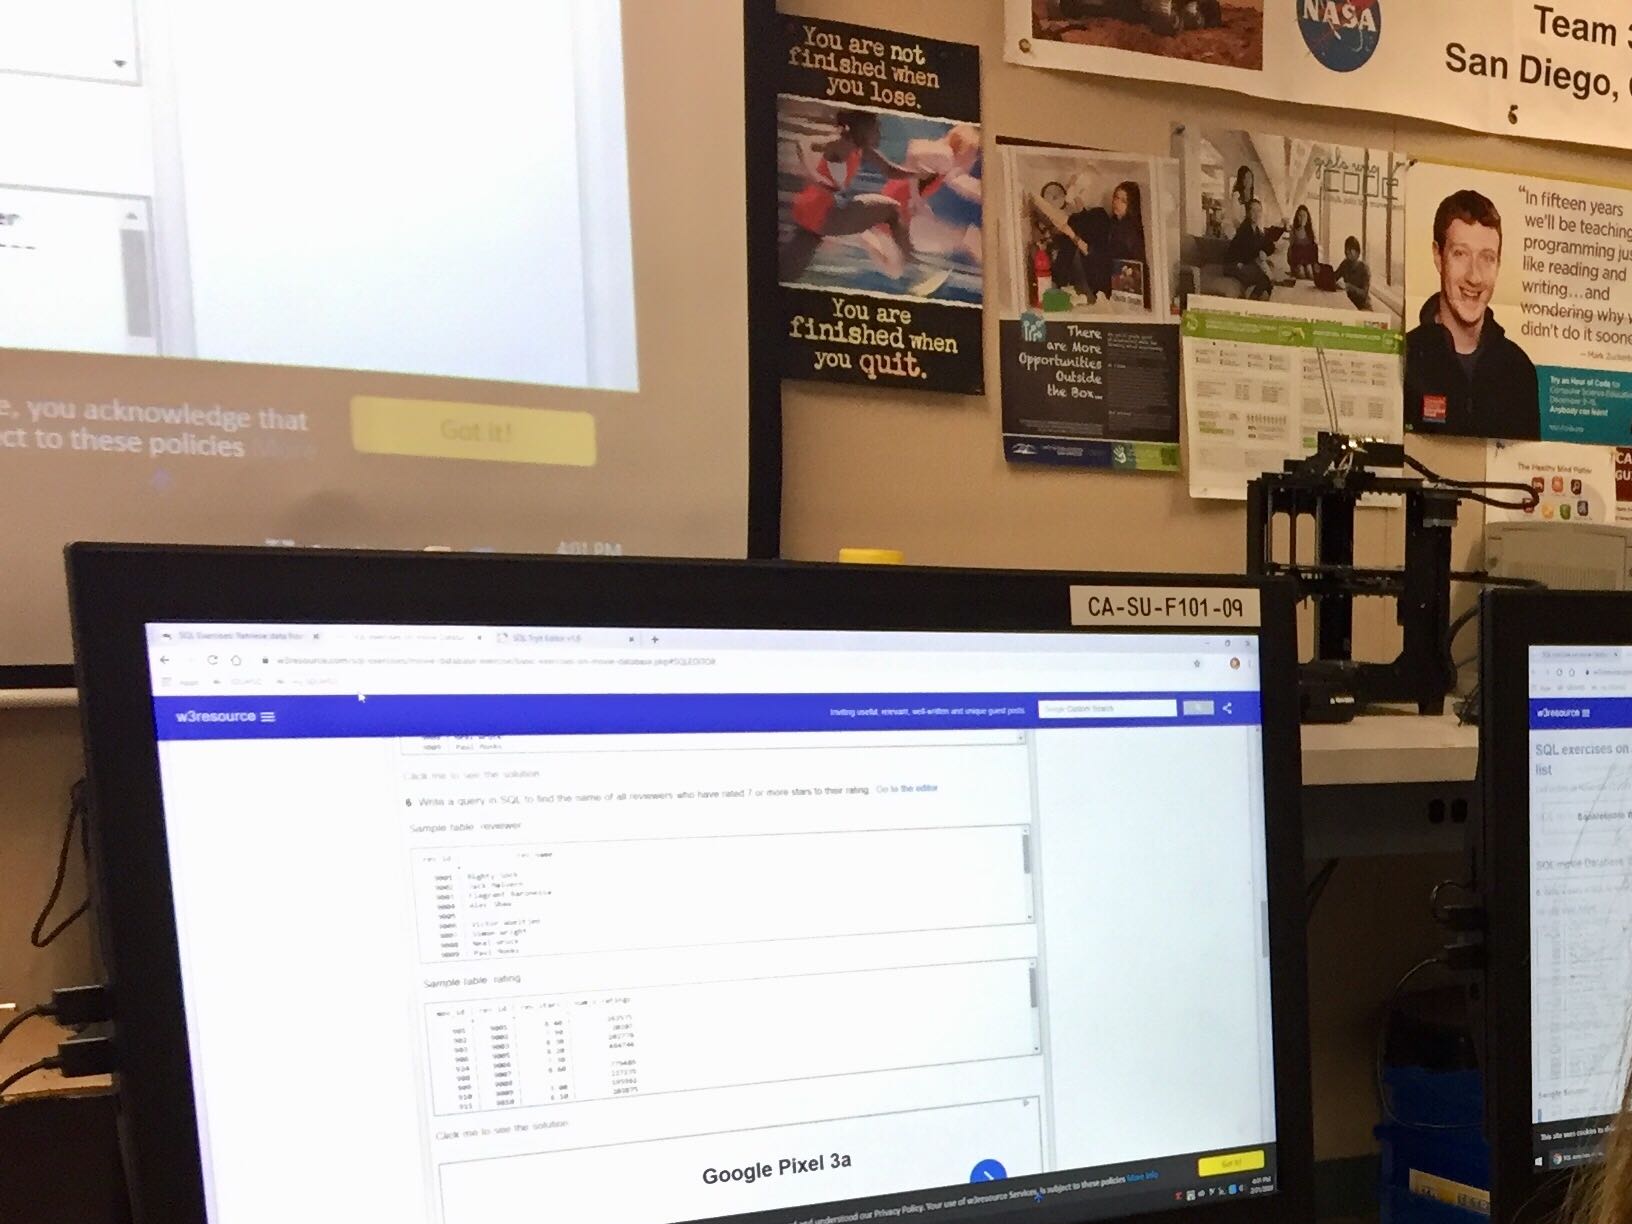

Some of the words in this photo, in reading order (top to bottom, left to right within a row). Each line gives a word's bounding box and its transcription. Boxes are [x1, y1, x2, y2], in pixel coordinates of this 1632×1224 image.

[1301, 1, 1378, 33] NASA
[1534, 5, 1617, 46] Team
[803, 25, 843, 50] You
[849, 38, 884, 56] are
[891, 44, 925, 65] not
[788, 47, 887, 80] finished
[891, 65, 940, 89] when
[1445, 42, 1508, 80] San
[1519, 54, 1618, 102] Diego,
[826, 76, 864, 96] you
[870, 81, 922, 109] lose.
[1541, 192, 1586, 211] fifteen
[1590, 202, 1624, 217] years
[1525, 214, 1555, 230] we'll
[1559, 216, 1576, 232] be
[1524, 237, 1615, 262] programming
[1523, 256, 1544, 272] like
[1549, 261, 1599, 281] reading
[1602, 267, 1627, 282] and
[832, 297, 869, 320] You
[876, 308, 911, 324] are
[1520, 302, 1593, 323] wondering
[1597, 308, 1624, 326] why
[789, 315, 905, 349] finished
[909, 332, 958, 354] when
[1067, 325, 1102, 339] There
[1521, 321, 1559, 338] didn't
[1562, 326, 1580, 340] do
[1584, 328, 1592, 341] it
[1047, 342, 1067, 352] are
[1072, 342, 1102, 354] More
[814, 351, 852, 370] you
[859, 351, 927, 380] quit.
[1019, 352, 1102, 371] Opportunities
[1056, 370, 1102, 385] Outside
[1047, 384, 1067, 397] the
[28, 400, 75, 422] you
[84, 399, 250, 432] acknowledge
[259, 407, 308, 431] that
[36, 430, 63, 449] to
[71, 428, 142, 451] these
[150, 433, 245, 458] policies
[441, 419, 480, 442] Got
[1088, 596, 1243, 618] CA-SU-F101-09
[176, 710, 256, 723] w3resource
[1536, 744, 1559, 756] SQL
[1562, 744, 1612, 756] exercises
[1616, 744, 1629, 754] on
[1536, 765, 1552, 776] list
[702, 1162, 772, 1185] Google
[779, 1155, 824, 1176] Pixel
[830, 1153, 852, 1169] 3a
[860, 1211, 872, 1220] our
[874, 1207, 901, 1219] Privacy
[927, 1201, 943, 1211] Your
[944, 1199, 956, 1208] use
[957, 1198, 966, 1206] of
[1047, 1183, 1072, 1195] subject
[1073, 1182, 1080, 1190] to
[1082, 1179, 1100, 1189] these
[1101, 1176, 1125, 1188] policies
